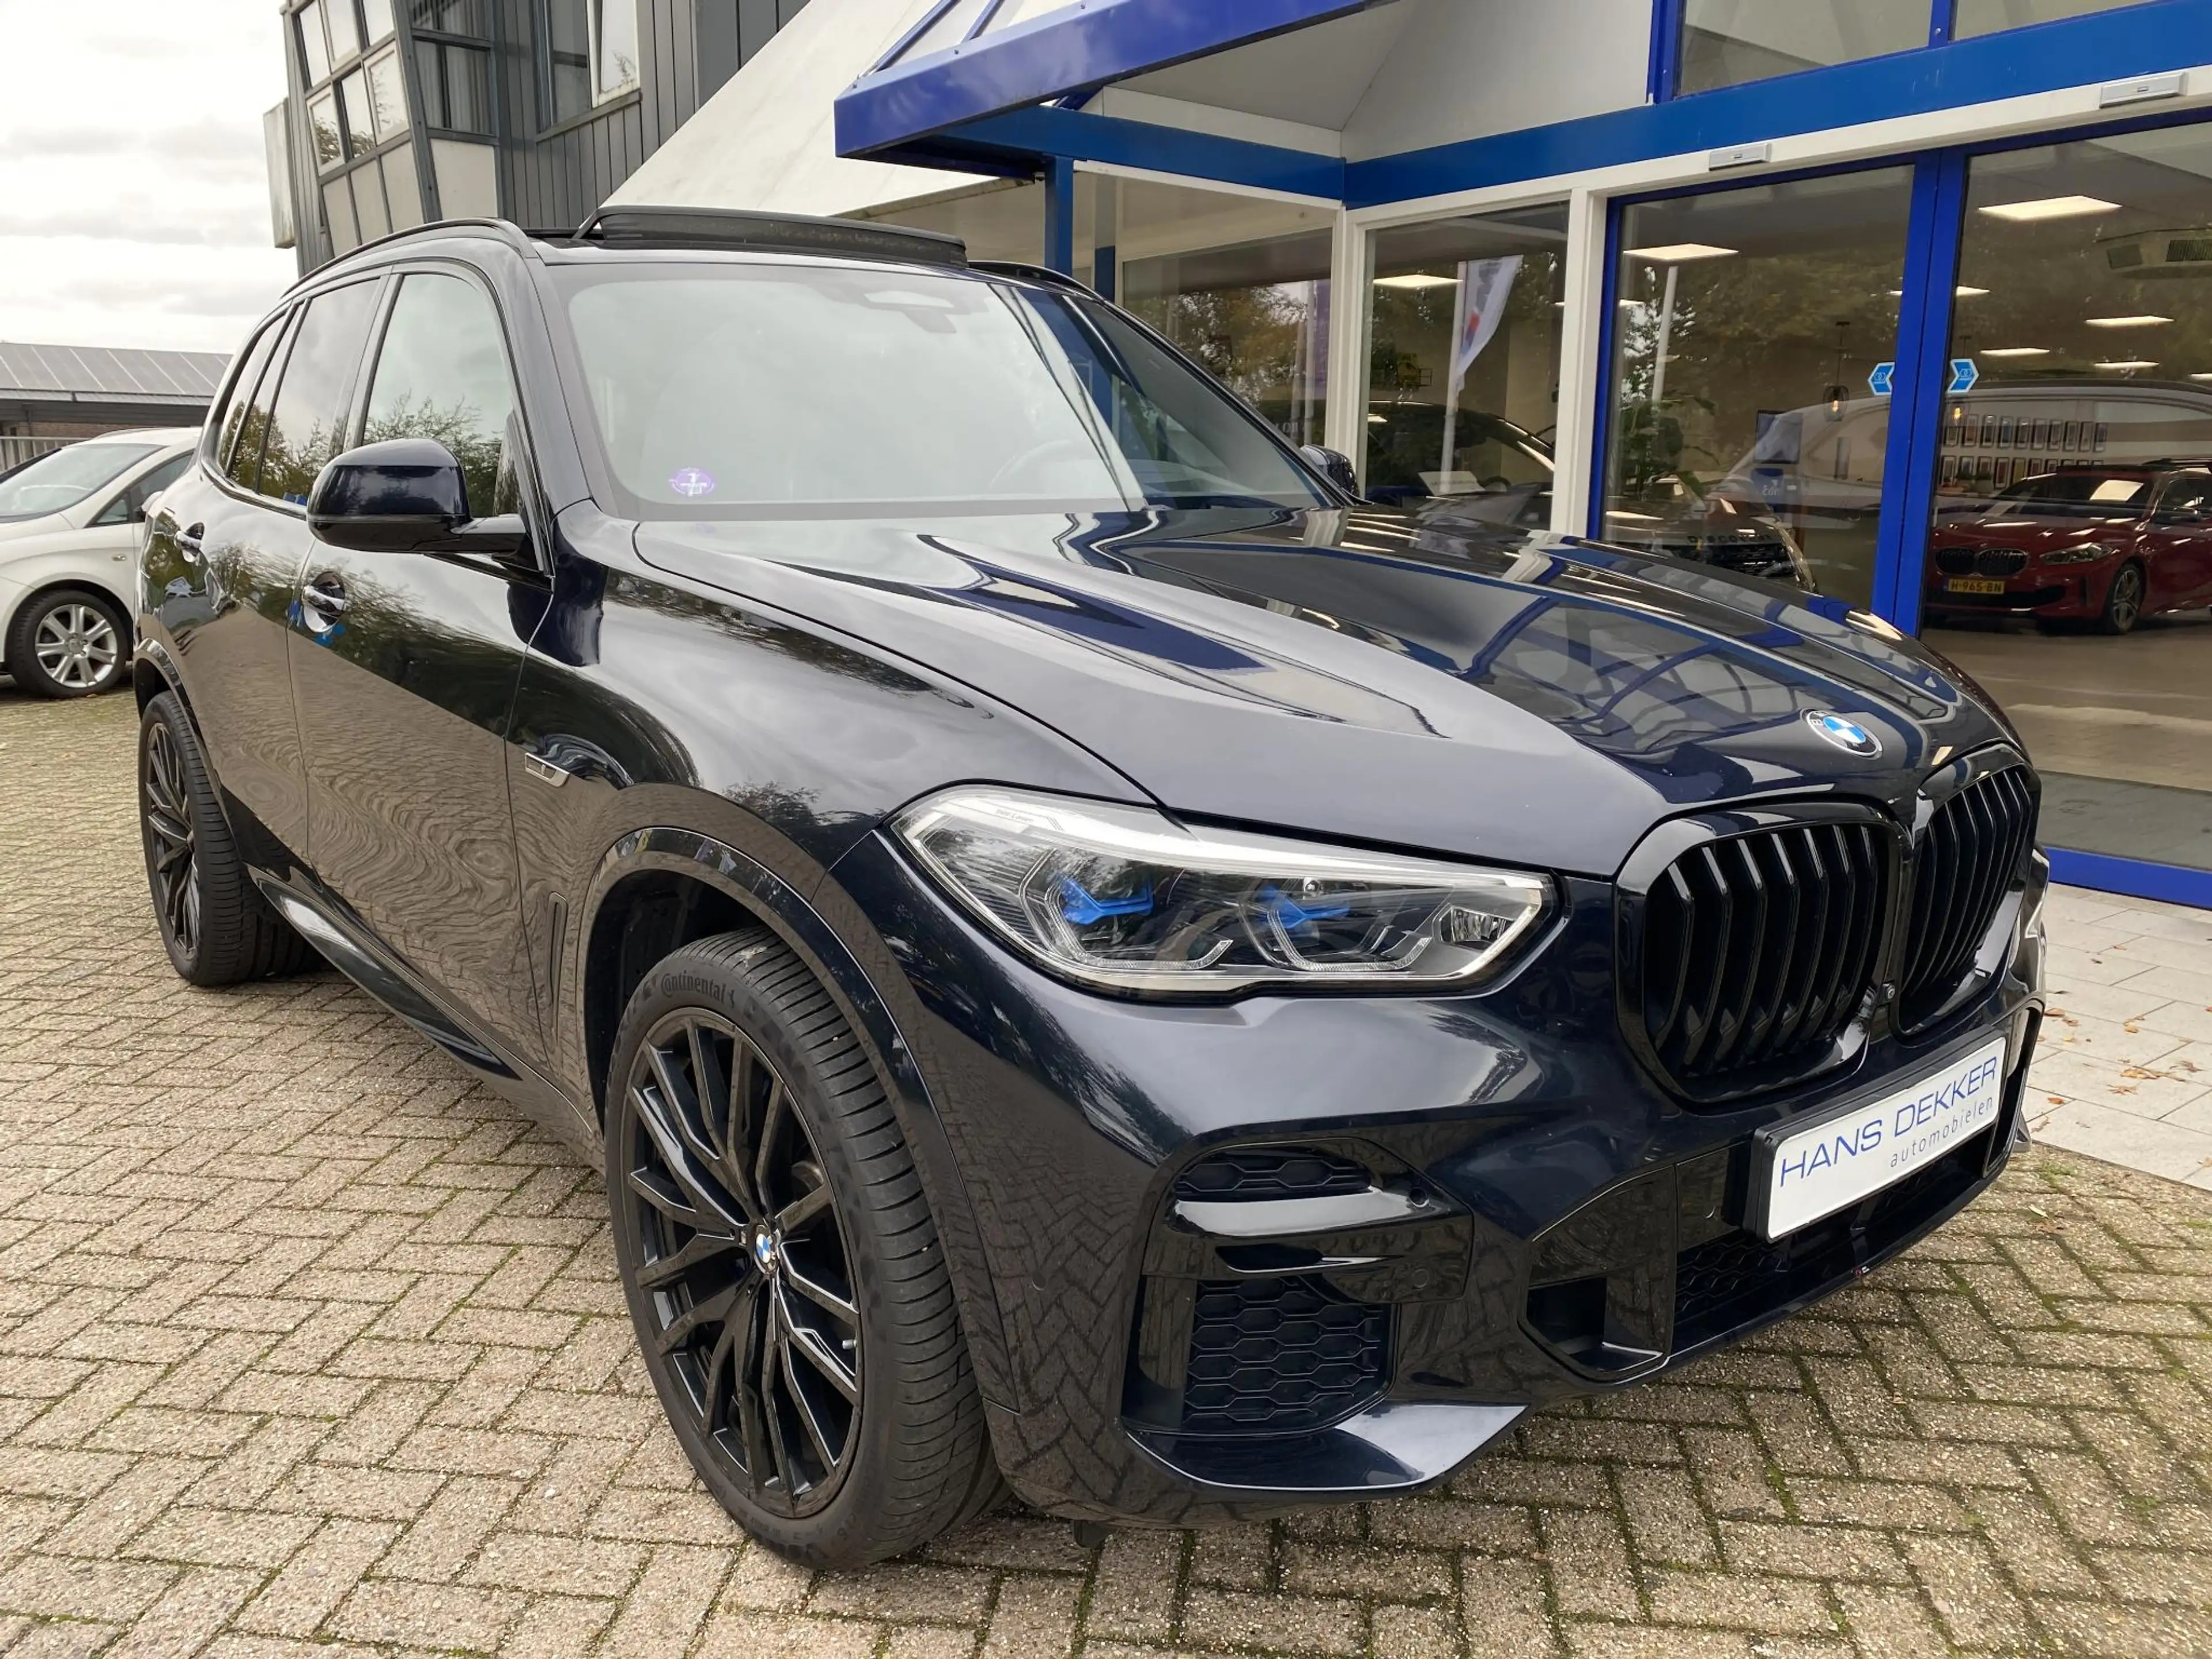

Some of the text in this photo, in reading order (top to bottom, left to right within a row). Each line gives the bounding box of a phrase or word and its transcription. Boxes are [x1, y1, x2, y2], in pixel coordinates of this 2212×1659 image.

[661, 970, 726, 1004] Continental
[1780, 1056, 1997, 1187] HANS DEKKER
[1890, 1097, 1993, 1167] automobielen
